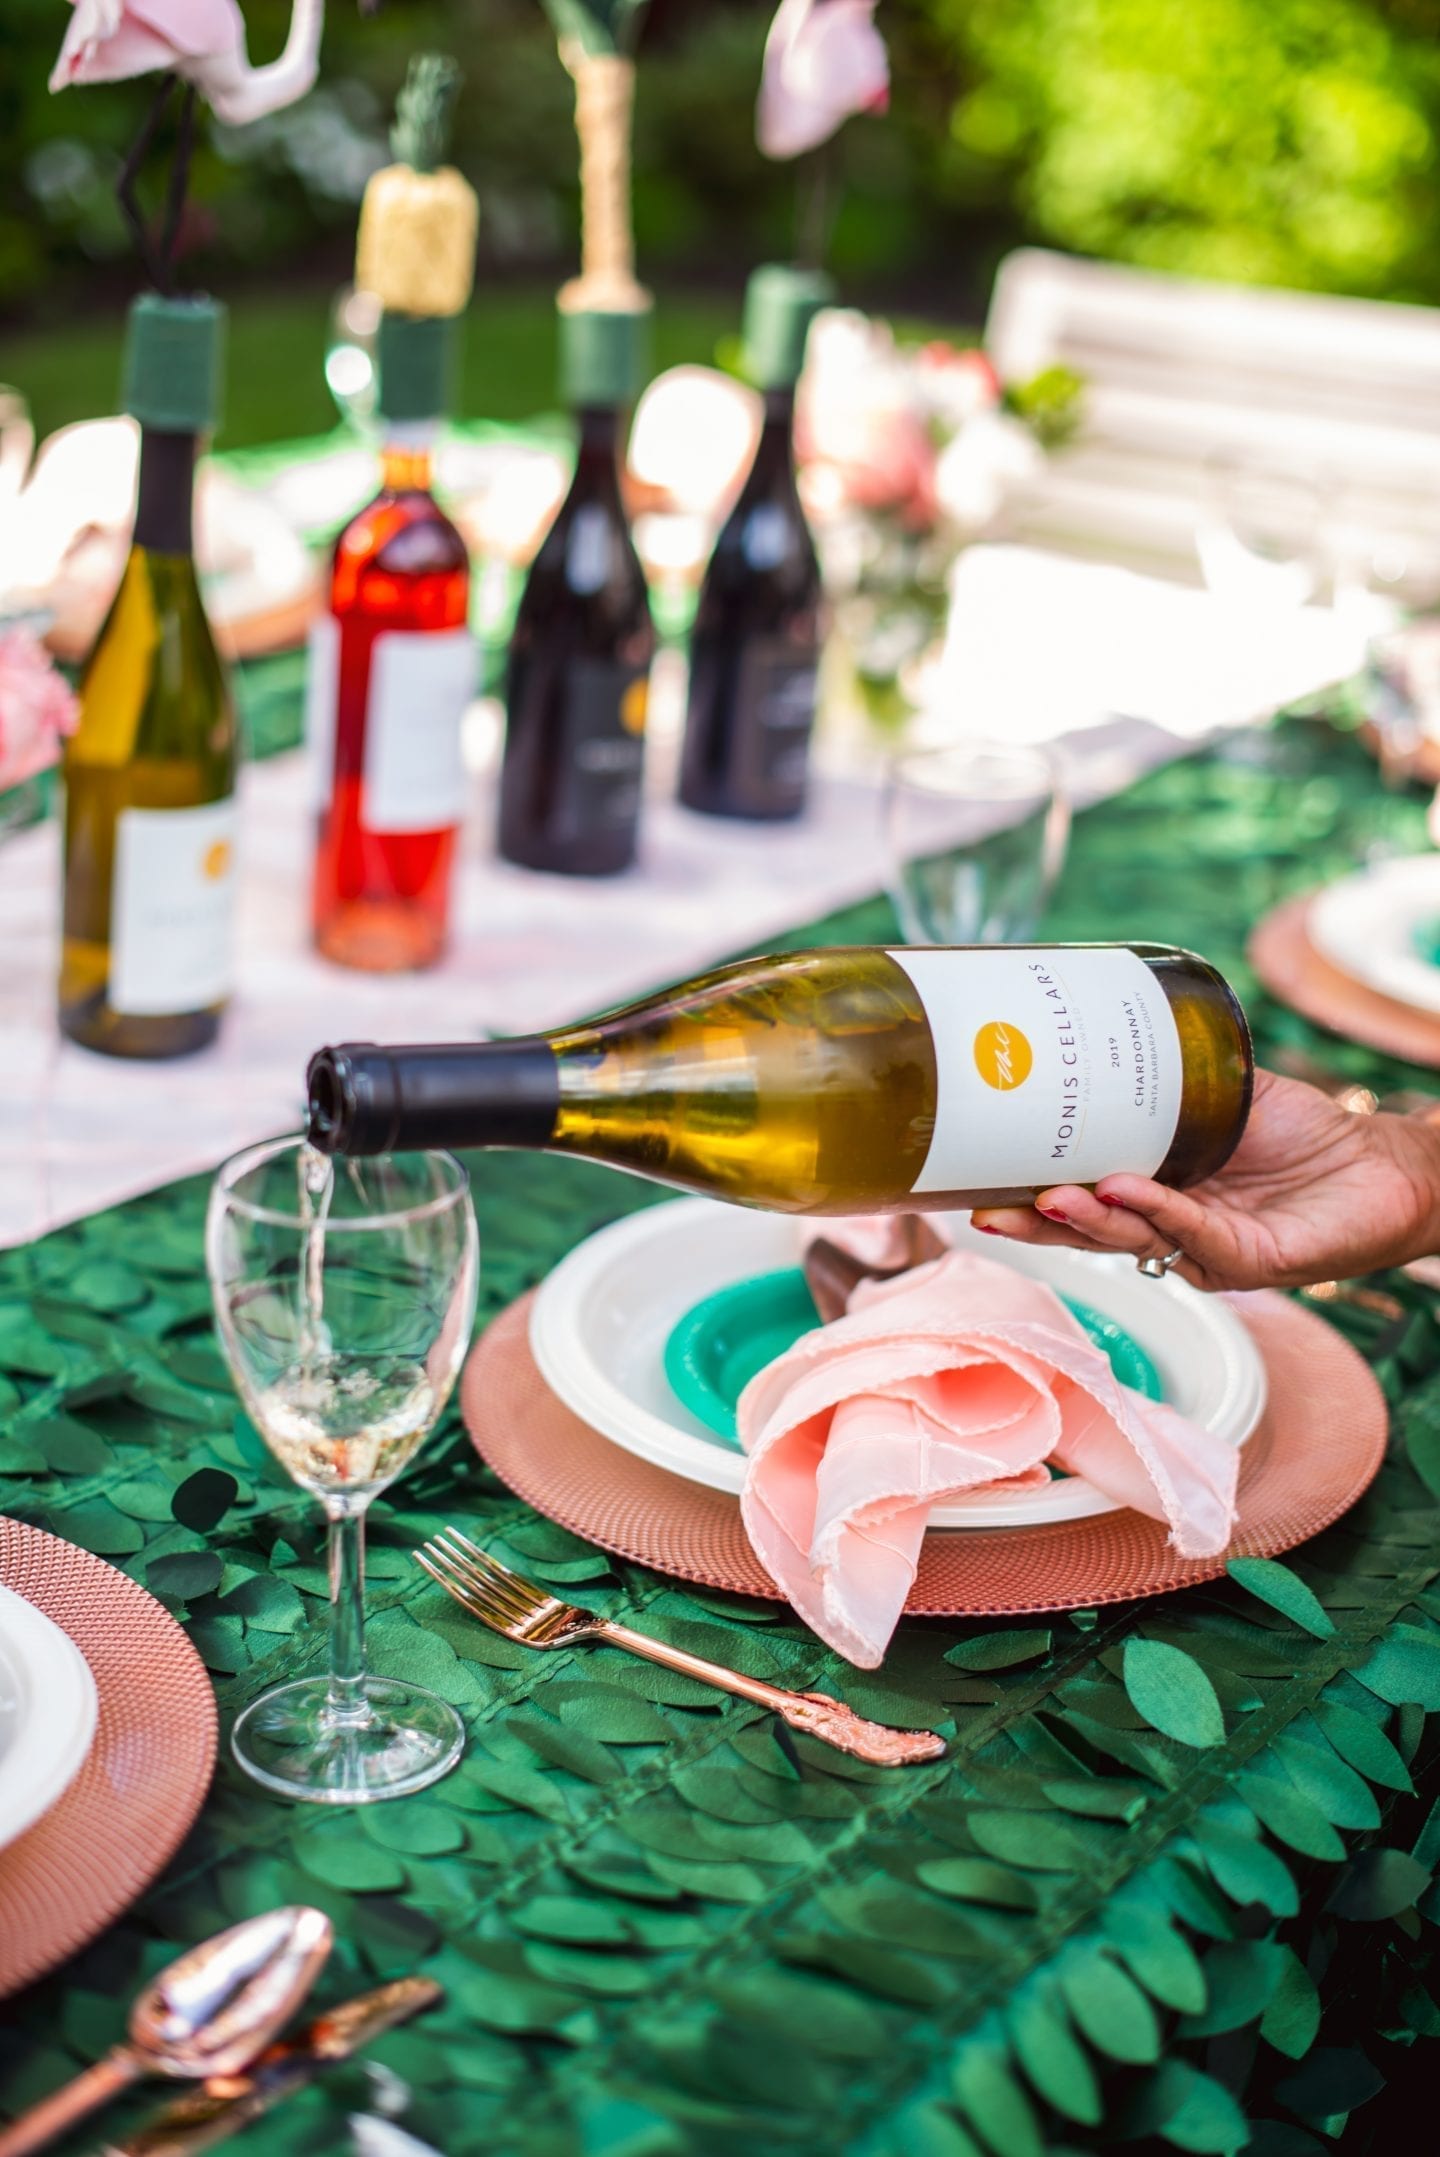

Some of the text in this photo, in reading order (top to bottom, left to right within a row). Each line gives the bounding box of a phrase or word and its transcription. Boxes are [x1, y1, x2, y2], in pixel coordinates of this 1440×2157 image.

[1028, 963, 1078, 1158] MONIS CELLARS
[1072, 1007, 1093, 1102] FAMILY OWNED
[1108, 1037, 1120, 1068] 2019
[1121, 1000, 1145, 1107] CHARDONNAY
[1133, 991, 1159, 1117] SANTA BARBARA COUNTY
